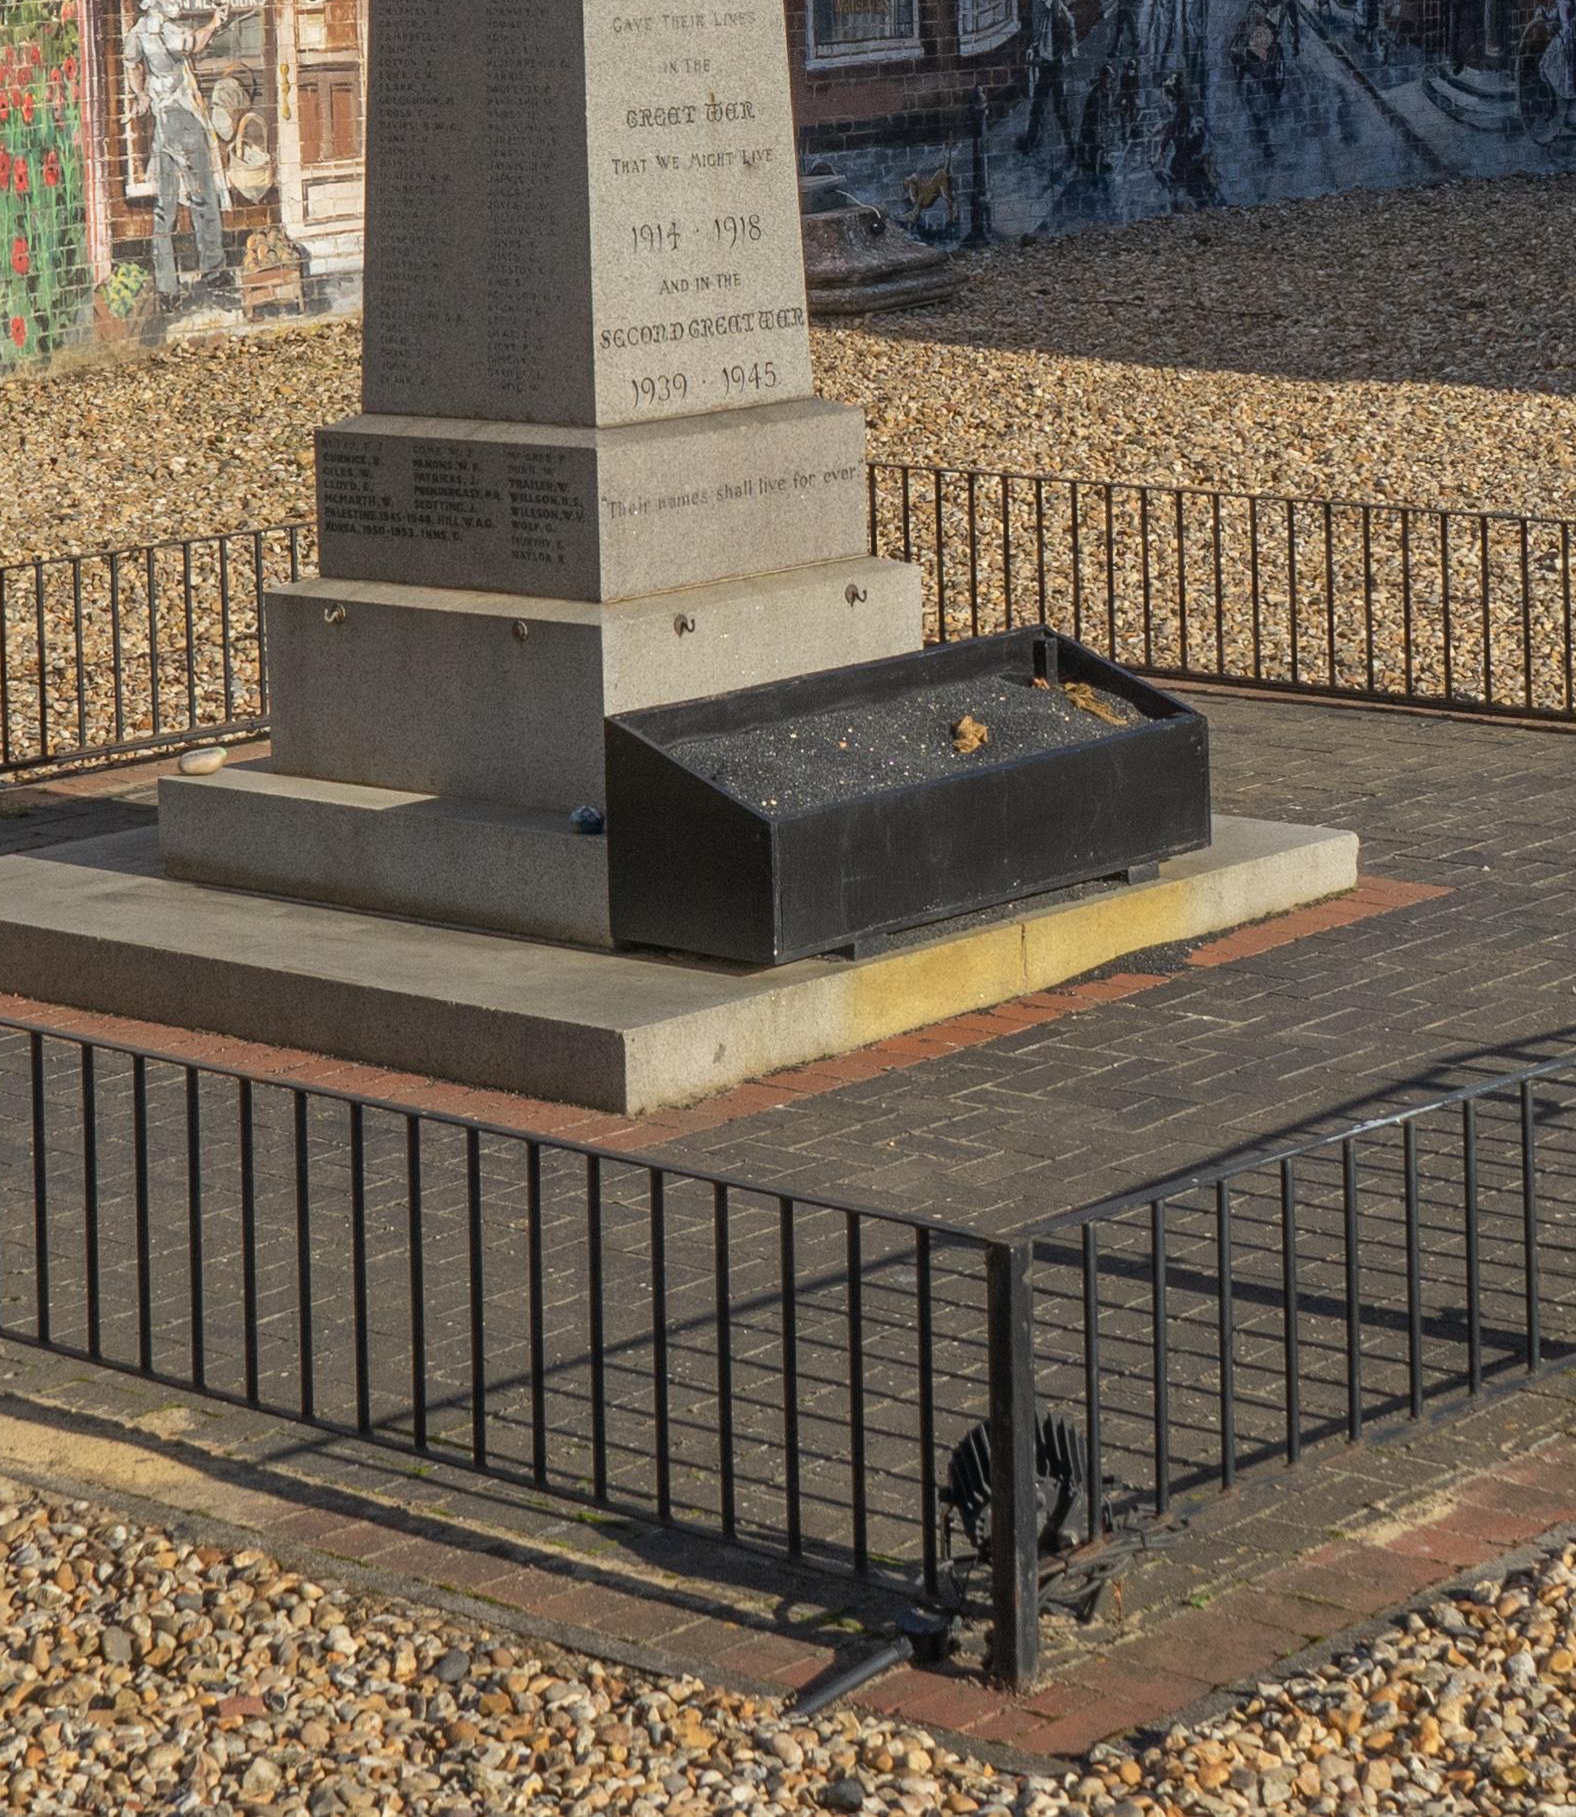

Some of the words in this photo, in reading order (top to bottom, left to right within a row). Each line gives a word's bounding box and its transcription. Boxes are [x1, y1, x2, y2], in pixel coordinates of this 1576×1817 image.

[626, 104, 697, 129] GREAT
[704, 100, 756, 123] WAR
[631, 222, 681, 254] 1914
[714, 214, 762, 249] 1918
[600, 321, 685, 350] SECOND
[688, 313, 756, 339] GREAT
[758, 306, 805, 331] WAR
[631, 372, 688, 408] 1939
[722, 361, 777, 395] 1945
[658, 490, 708, 511] names
[716, 479, 752, 502] shall
[759, 476, 786, 495] live
[793, 470, 816, 489] for
